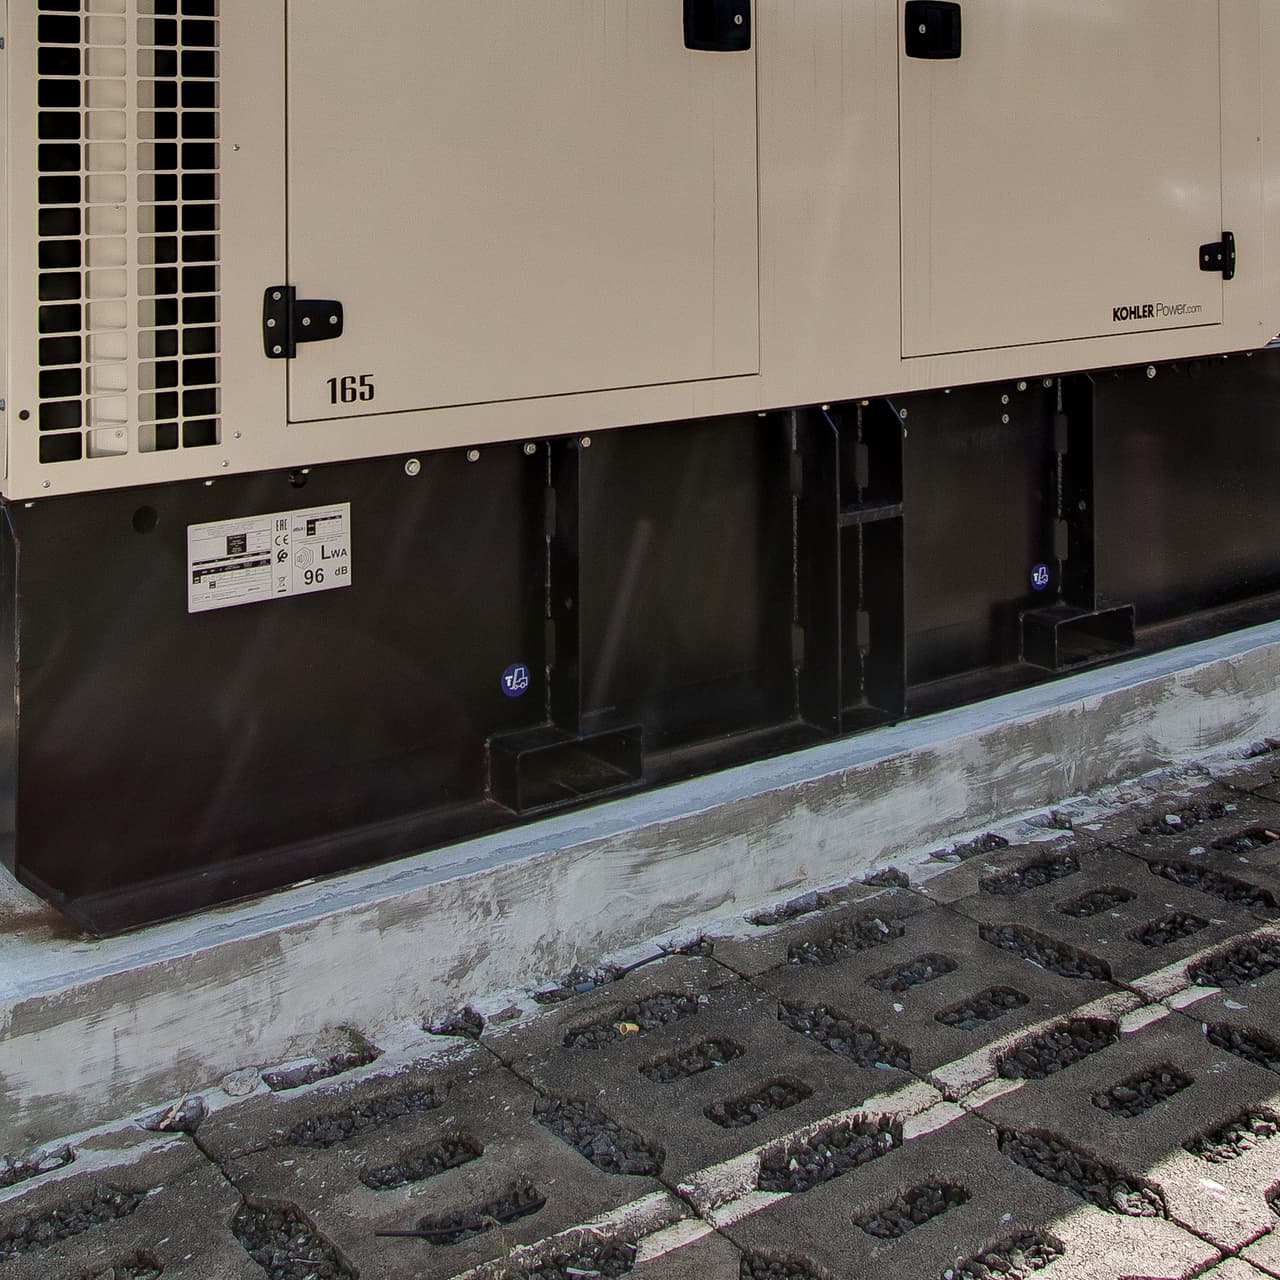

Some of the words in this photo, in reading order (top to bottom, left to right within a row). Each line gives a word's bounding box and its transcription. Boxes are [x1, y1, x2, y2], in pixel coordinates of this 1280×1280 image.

[1112, 303, 1155, 322] KOHLER
[326, 373, 375, 405] 165
[304, 567, 325, 585] 96
[334, 565, 348, 577] dB
